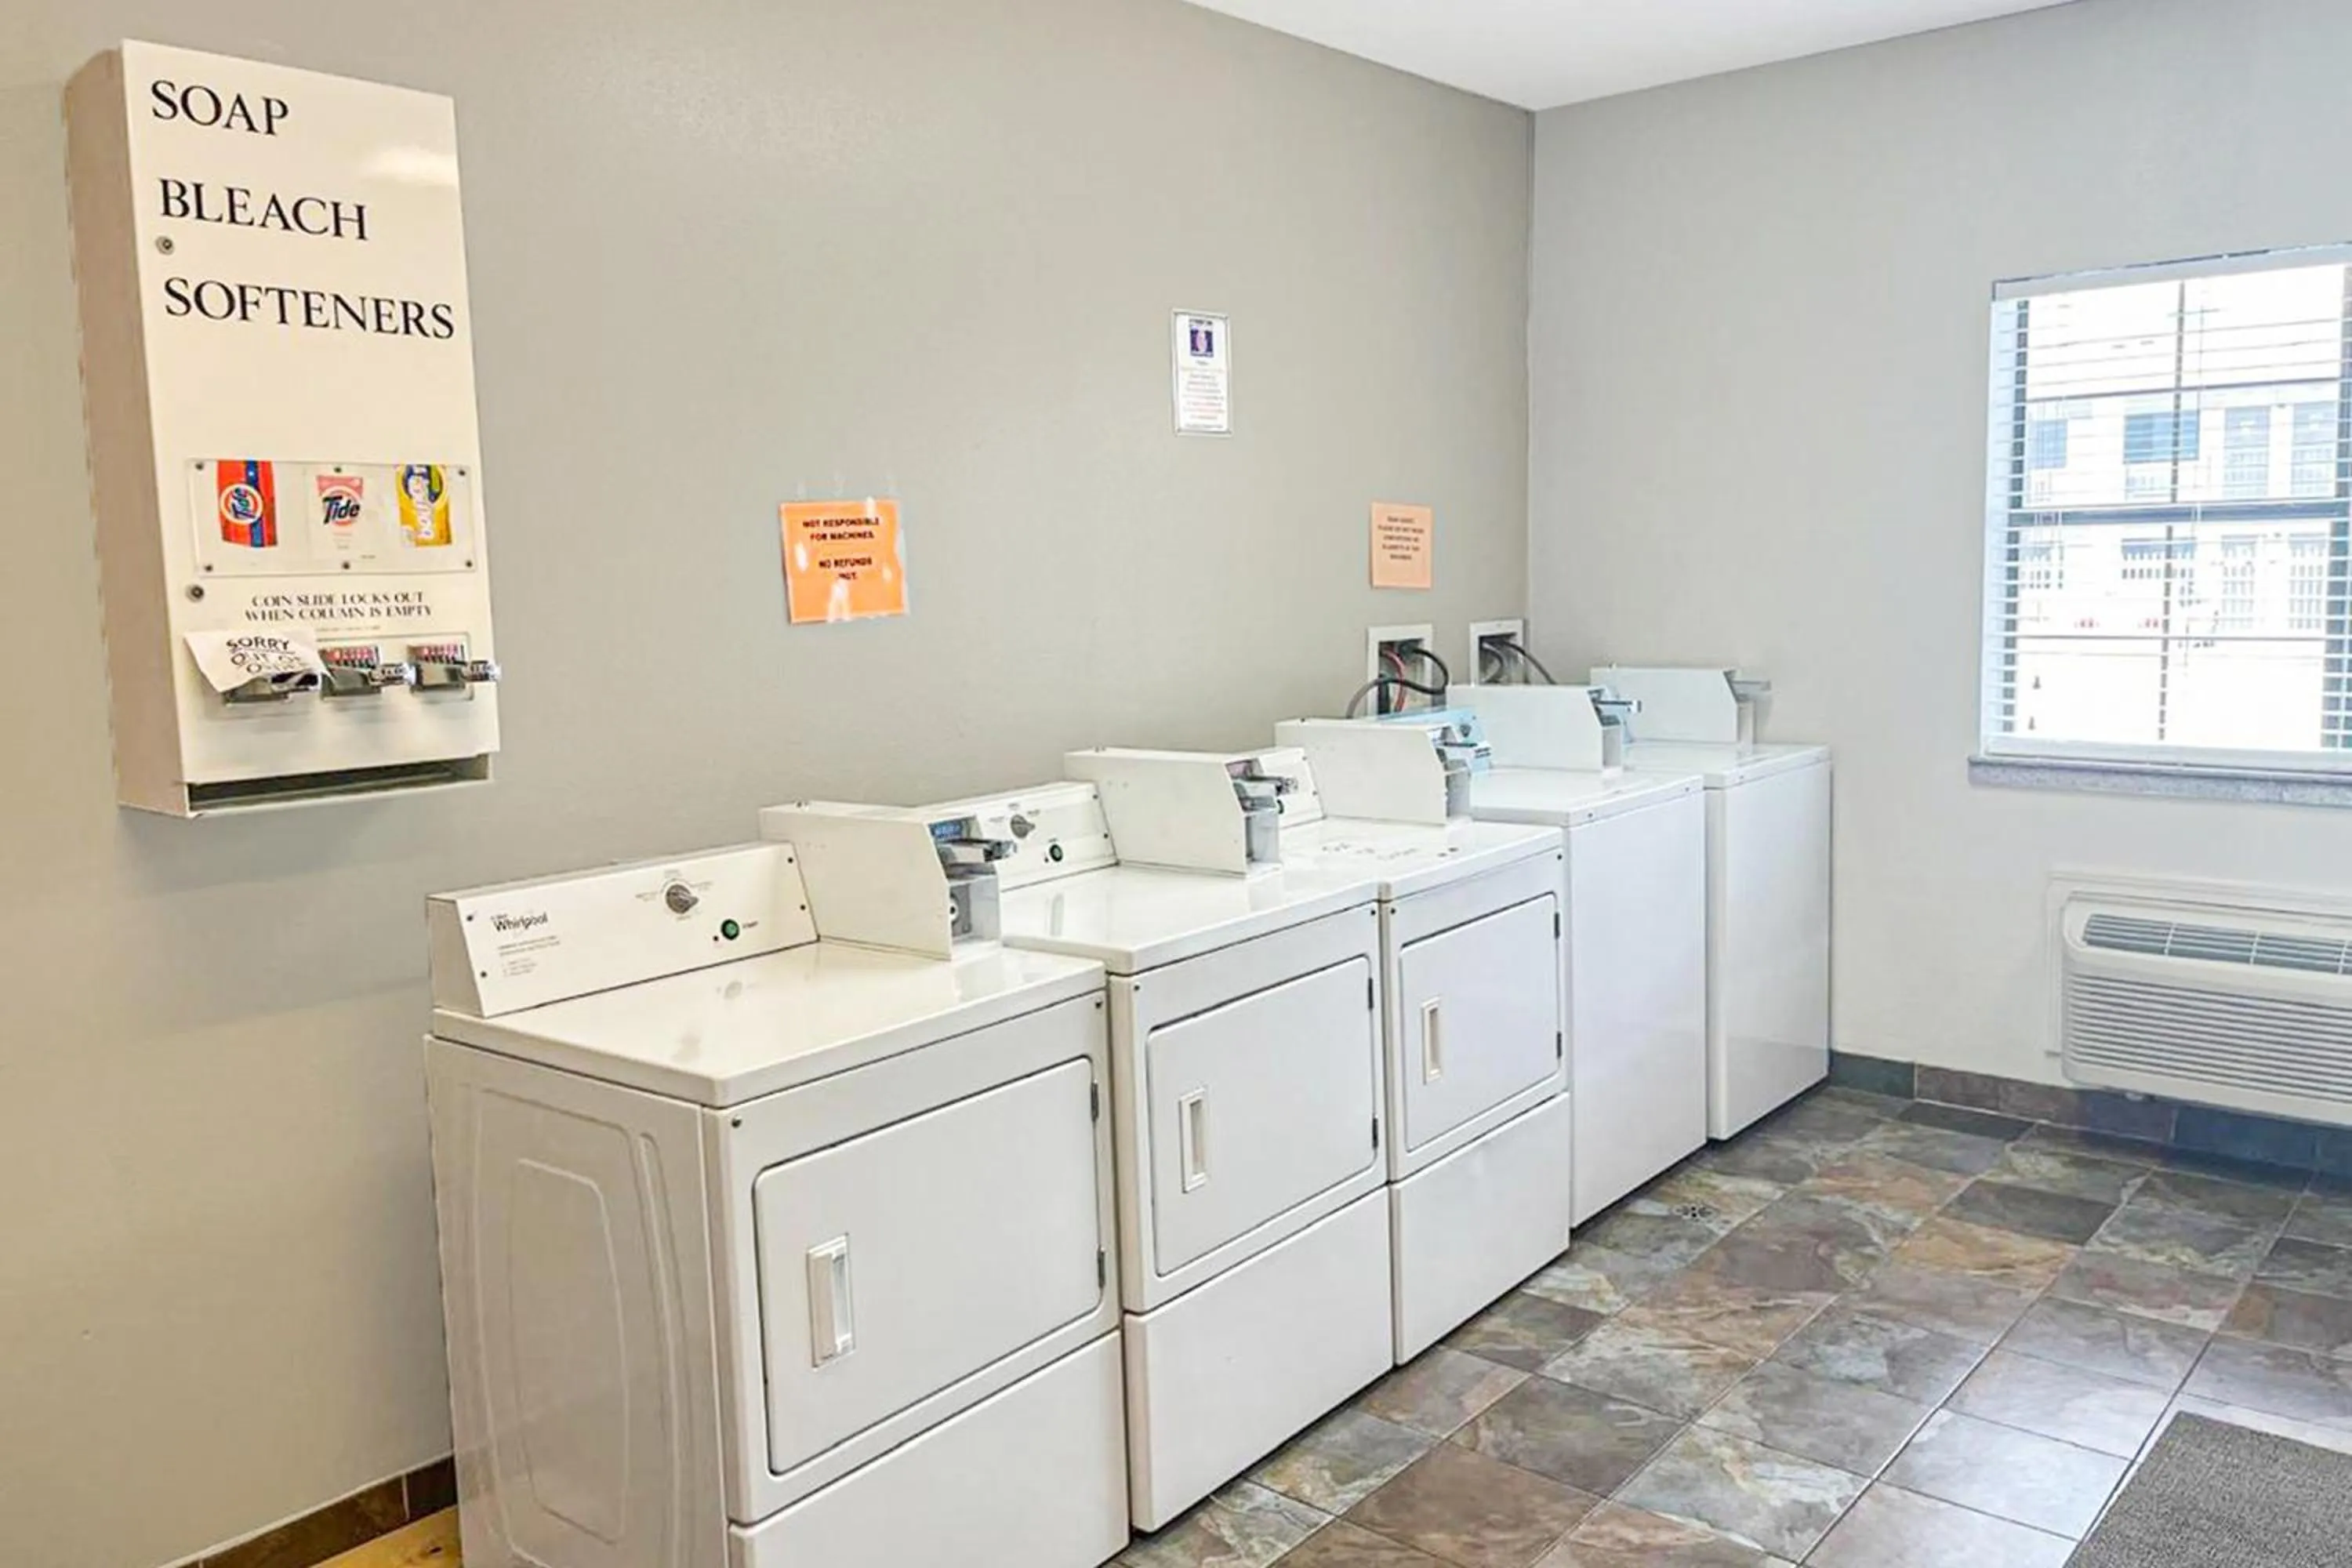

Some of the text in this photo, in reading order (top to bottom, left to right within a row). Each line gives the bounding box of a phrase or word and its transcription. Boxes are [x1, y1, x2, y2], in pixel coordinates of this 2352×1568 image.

[151, 80, 289, 136] SOAP
[158, 178, 368, 241] BLEACH
[164, 277, 454, 339] SOFTENERS
[322, 495, 361, 524] Tide
[803, 517, 880, 528] NOT RESPONSIBLE
[818, 560, 831, 568] NO
[251, 591, 424, 607] COIN SLIDE LOCKS OUT
[245, 604, 433, 622] WHEN COLUMN IS EMPTY
[226, 636, 290, 651] SORRY
[492, 912, 548, 931] Whirlpool
